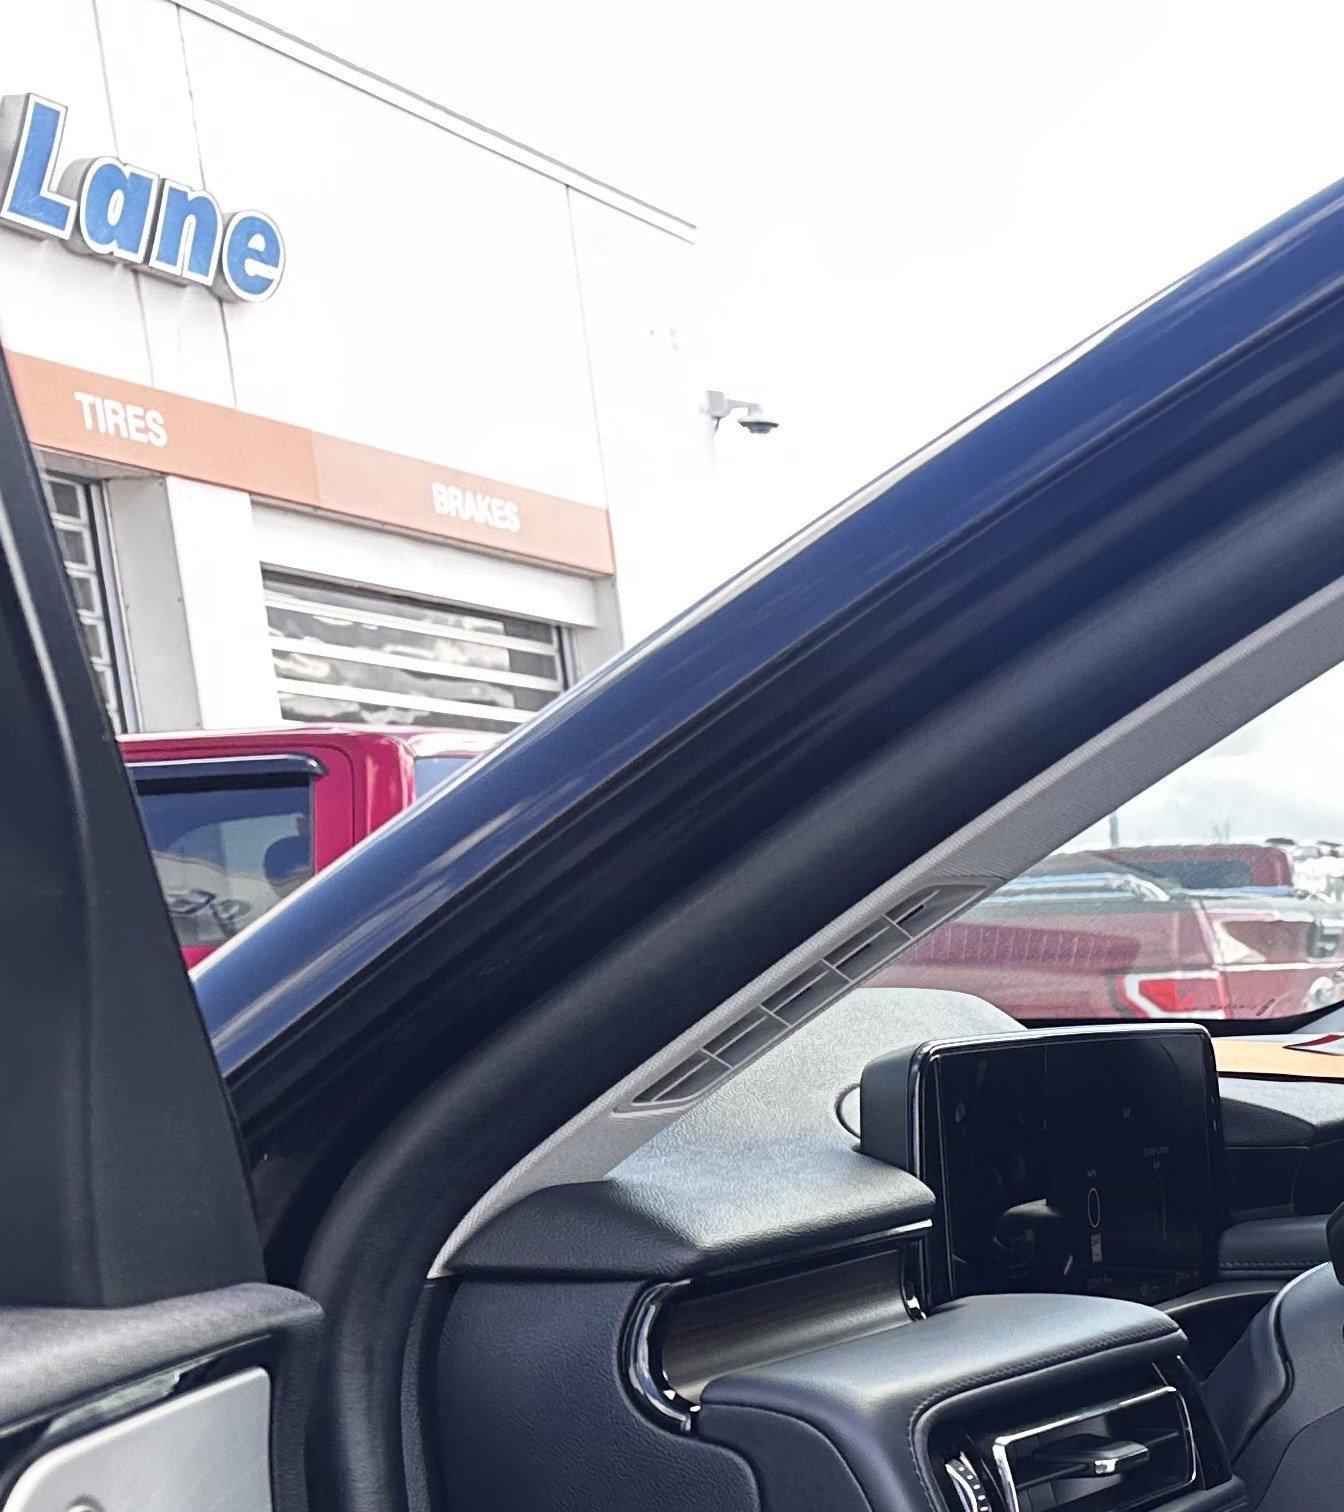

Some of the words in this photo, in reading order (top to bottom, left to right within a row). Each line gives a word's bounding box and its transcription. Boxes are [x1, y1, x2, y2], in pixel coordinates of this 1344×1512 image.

[1, 93, 286, 302] Lane
[73, 390, 168, 448] TIRES
[431, 481, 521, 532] BRAKES
